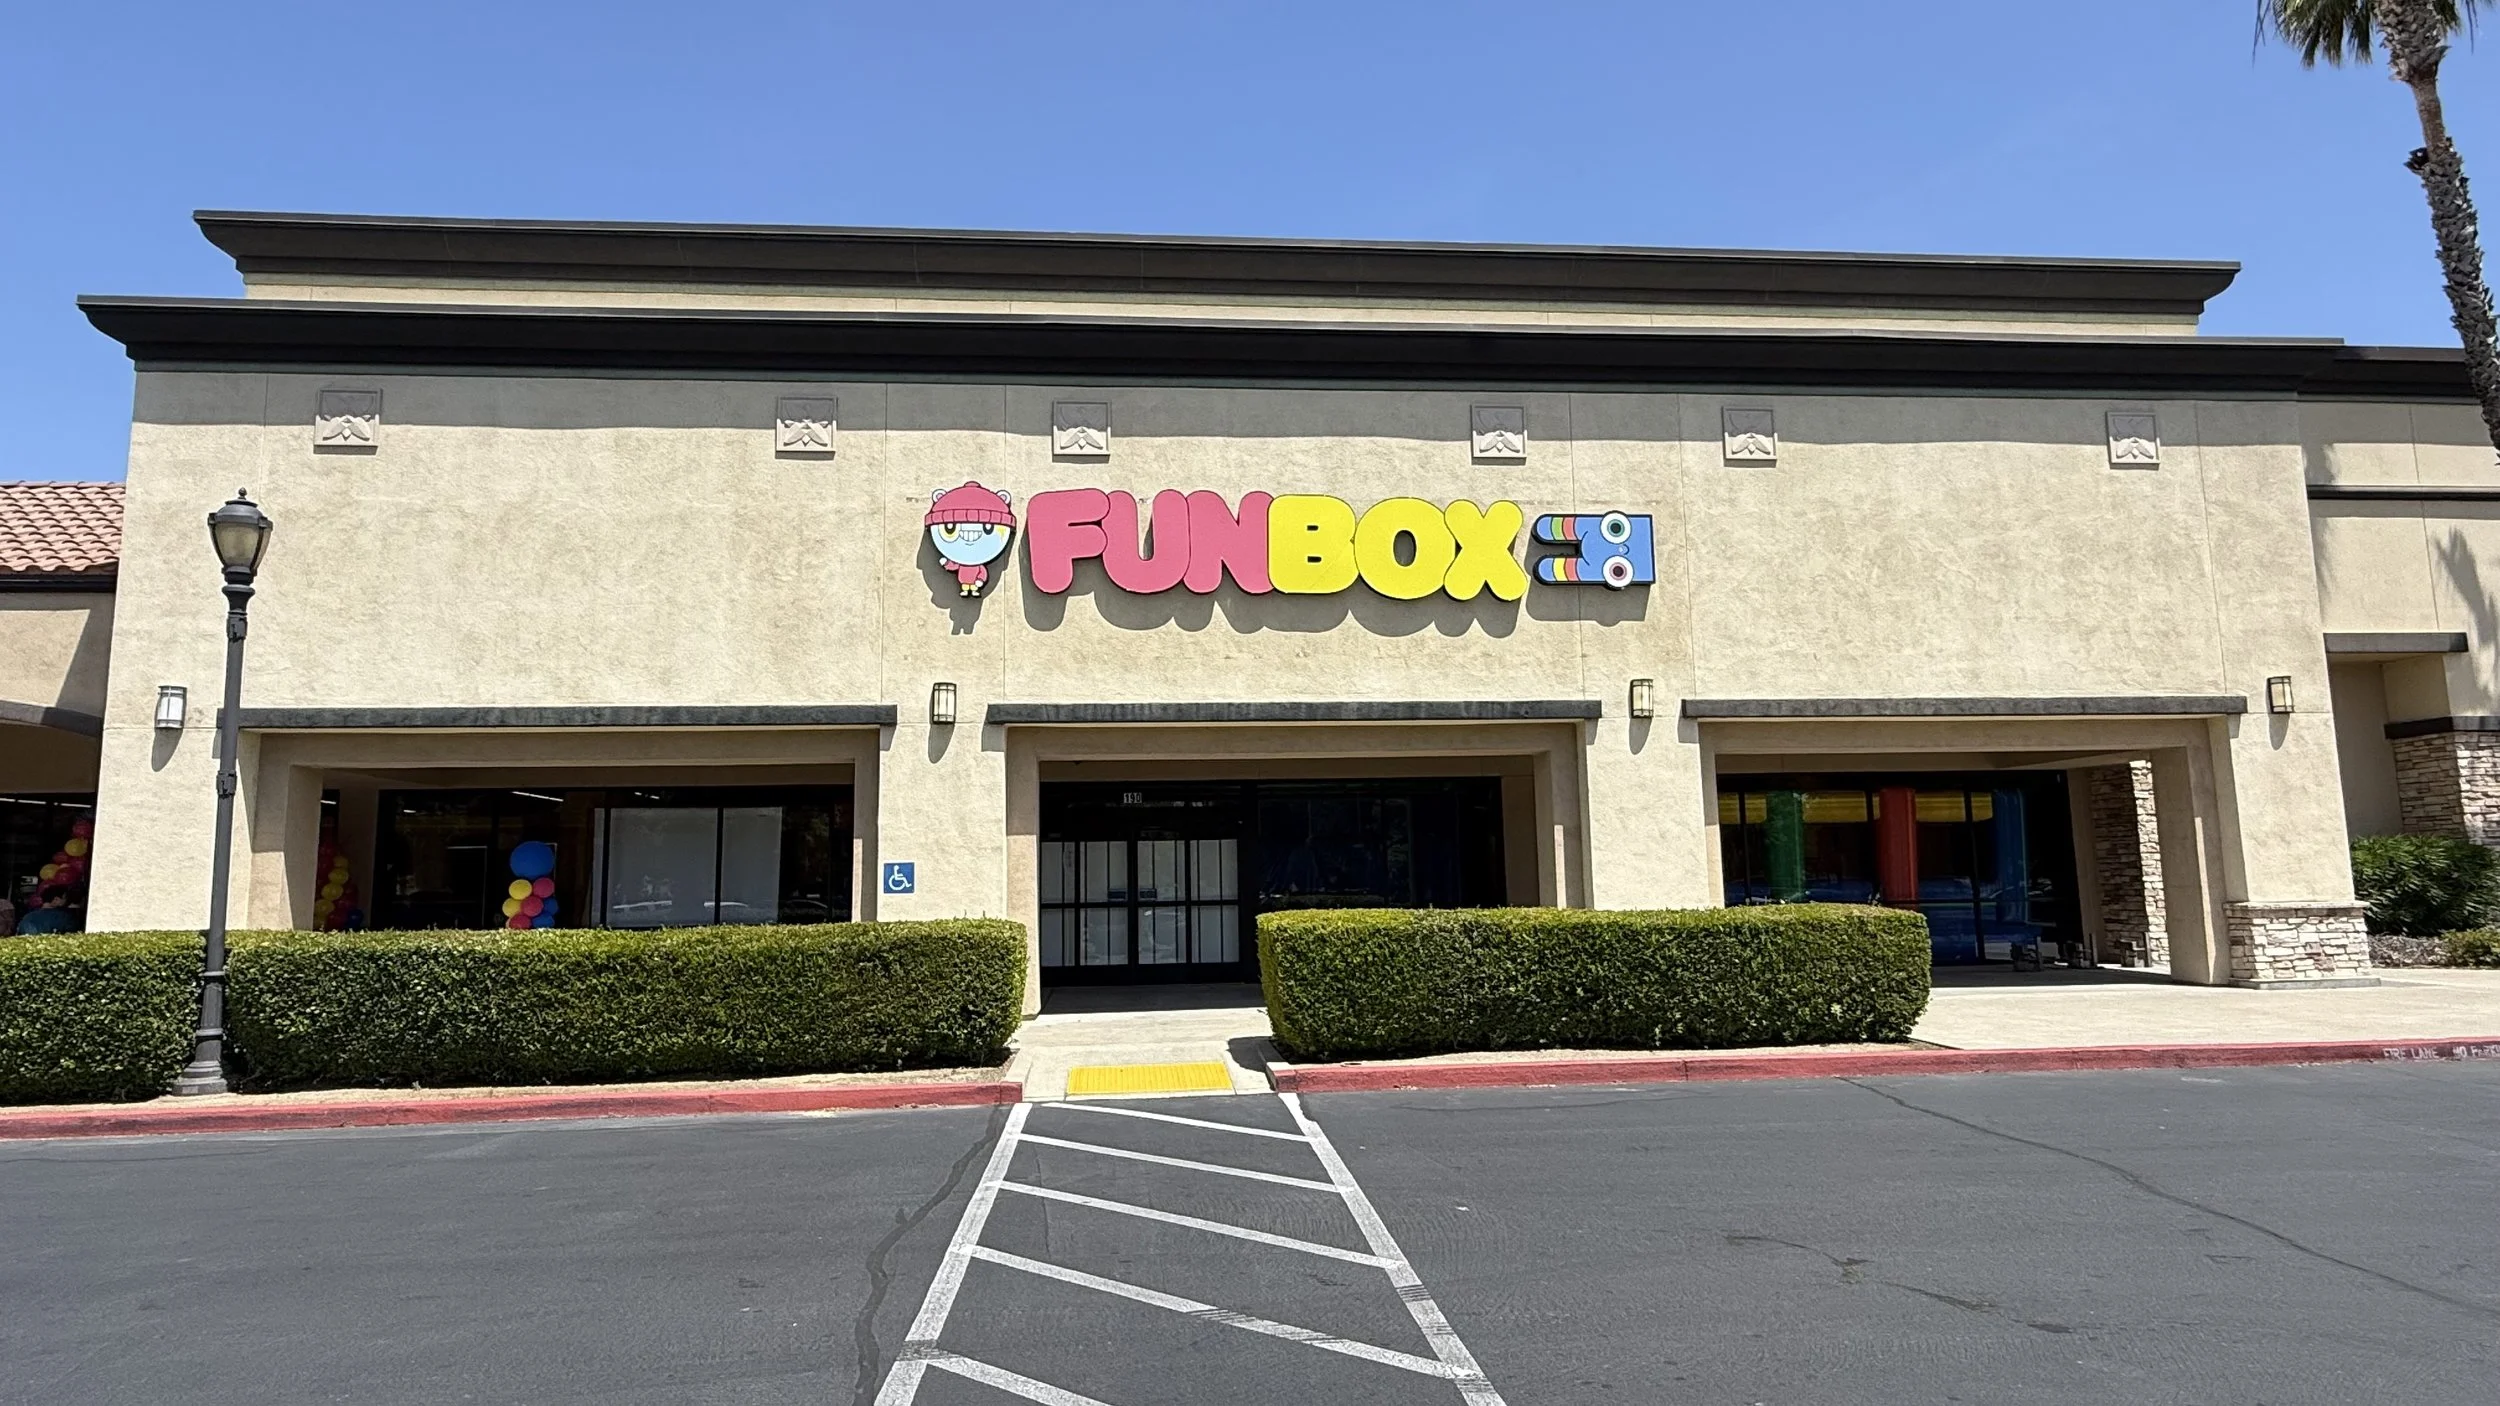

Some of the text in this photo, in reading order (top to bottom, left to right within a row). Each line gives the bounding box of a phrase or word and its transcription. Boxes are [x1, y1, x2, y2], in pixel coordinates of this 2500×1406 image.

[1027, 488, 1527, 601] FUNBOX
[2383, 1047, 2406, 1060] FIRE
[2410, 1046, 2440, 1059] LANE
